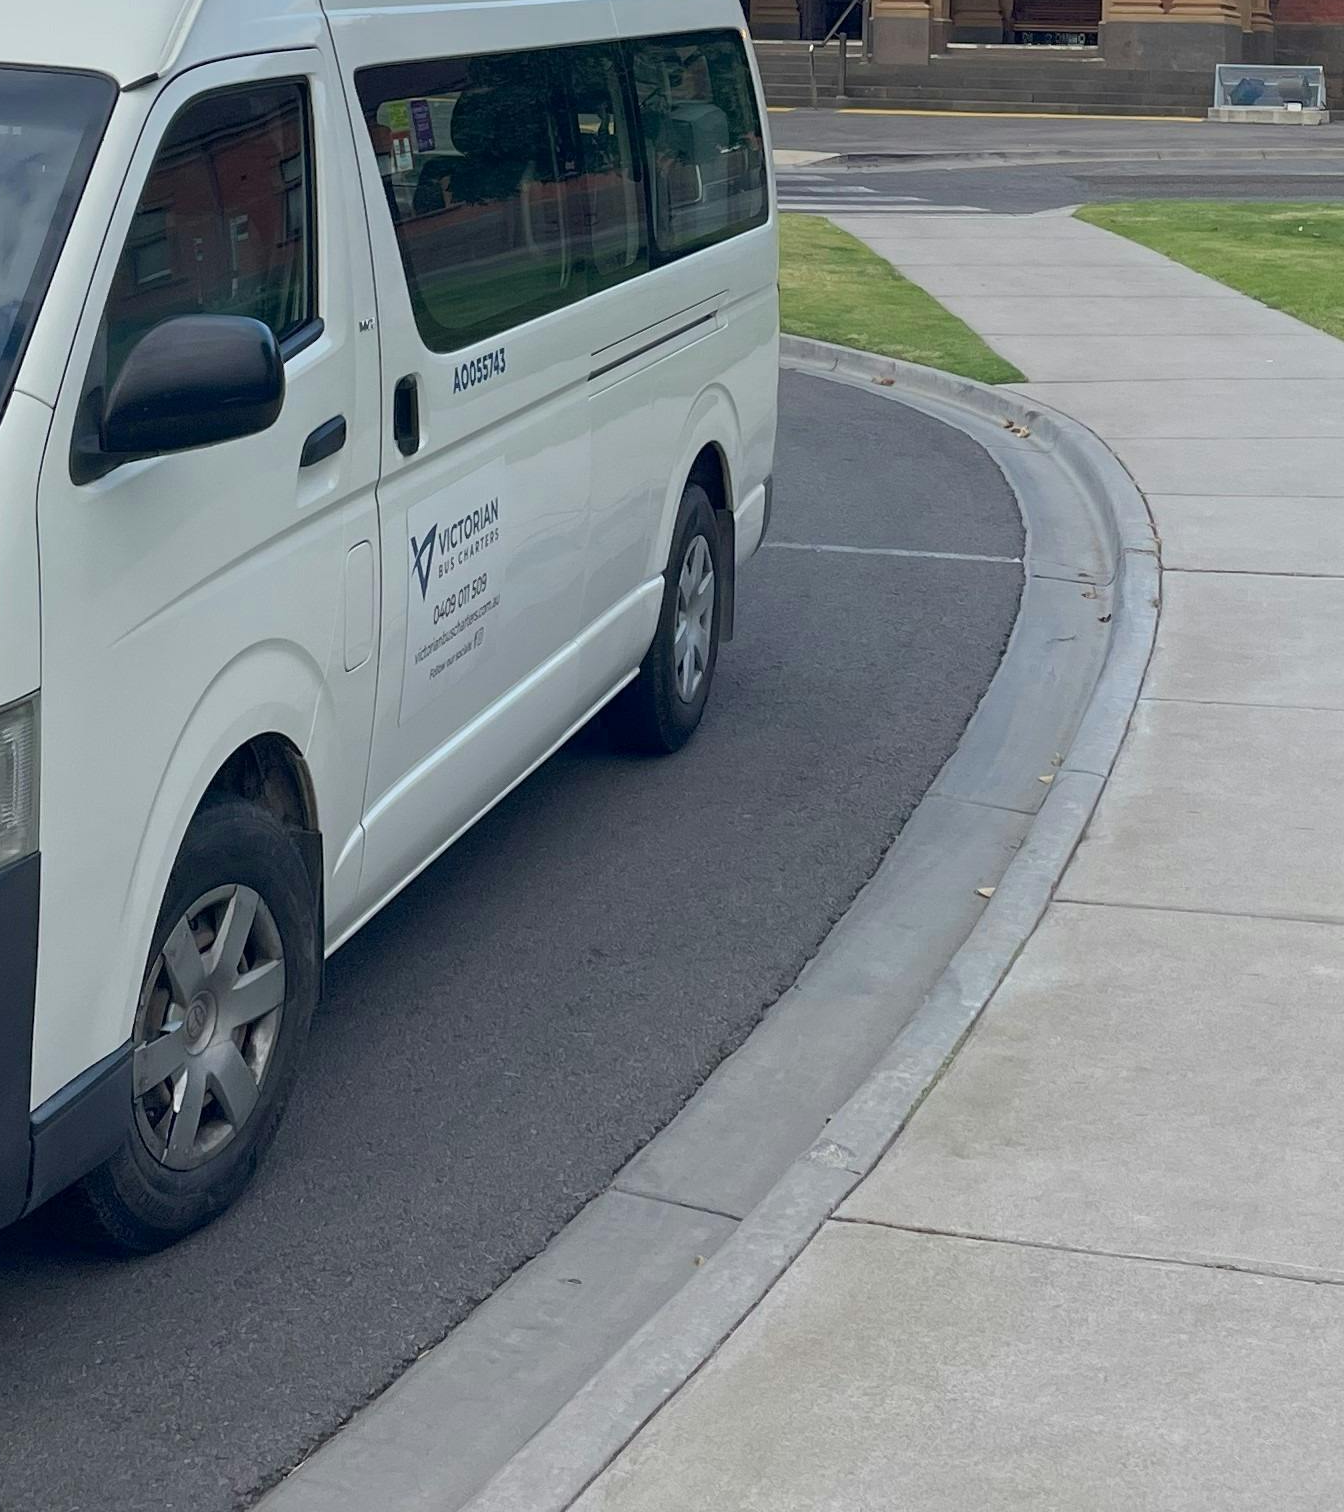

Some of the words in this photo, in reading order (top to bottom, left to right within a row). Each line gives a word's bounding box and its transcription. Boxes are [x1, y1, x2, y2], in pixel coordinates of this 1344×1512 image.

[439, 495, 499, 556] VICTORIAN
[438, 557, 455, 579] BUS
[458, 527, 500, 565] CHARTERS
[433, 593, 456, 625] 0409
[458, 583, 470, 608] 011
[471, 572, 488, 600] 509
